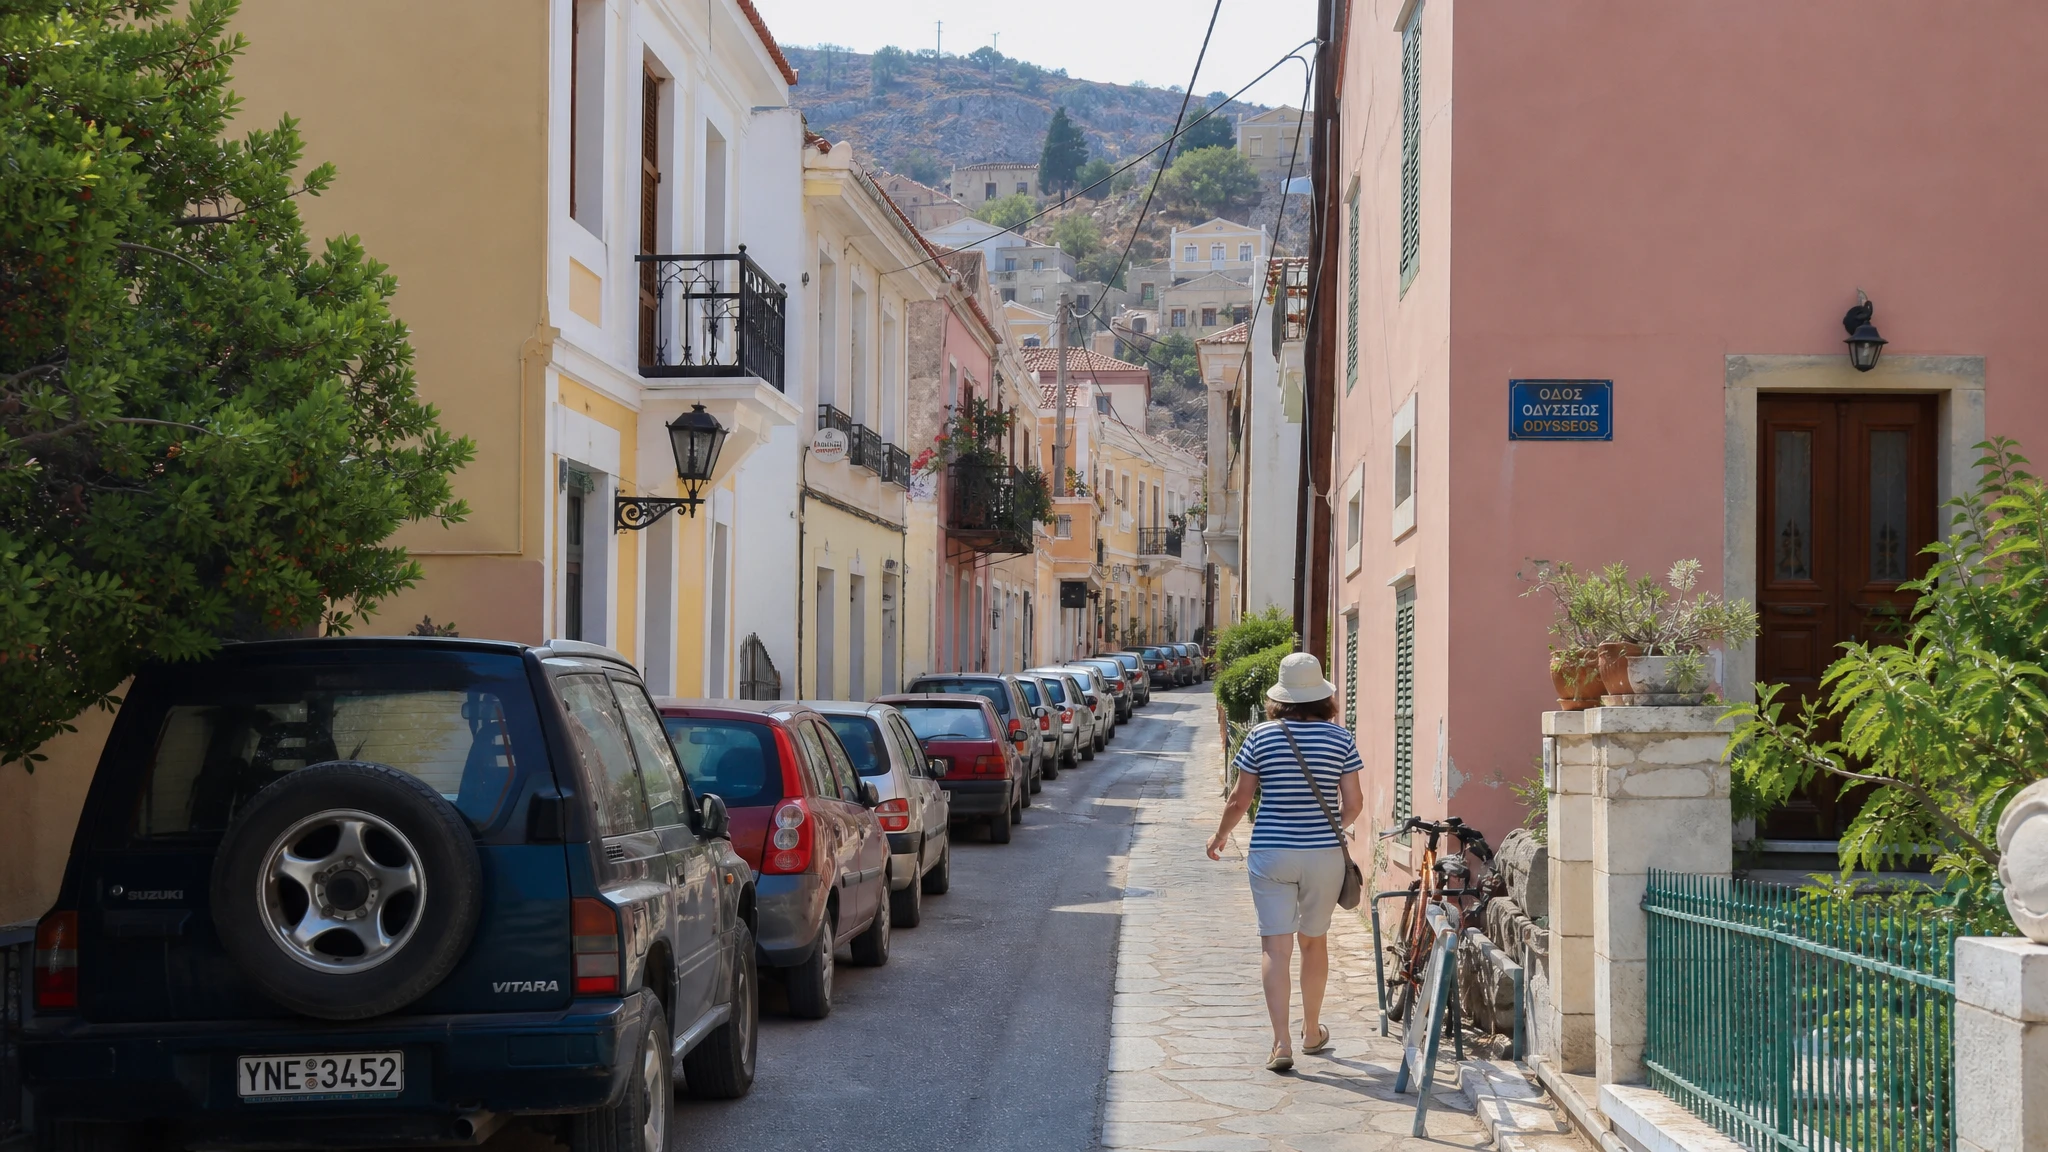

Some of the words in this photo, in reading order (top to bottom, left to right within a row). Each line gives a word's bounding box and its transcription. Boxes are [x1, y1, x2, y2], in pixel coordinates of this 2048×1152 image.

[1539, 388, 1583, 400] ΟΔΟΣ
[1522, 404, 1600, 416] ΟΔΥΣΣΕΩΣ
[1523, 420, 1599, 432] ODYSSEOS
[127, 890, 184, 900] SUZUKI
[492, 980, 559, 993] VITARA
